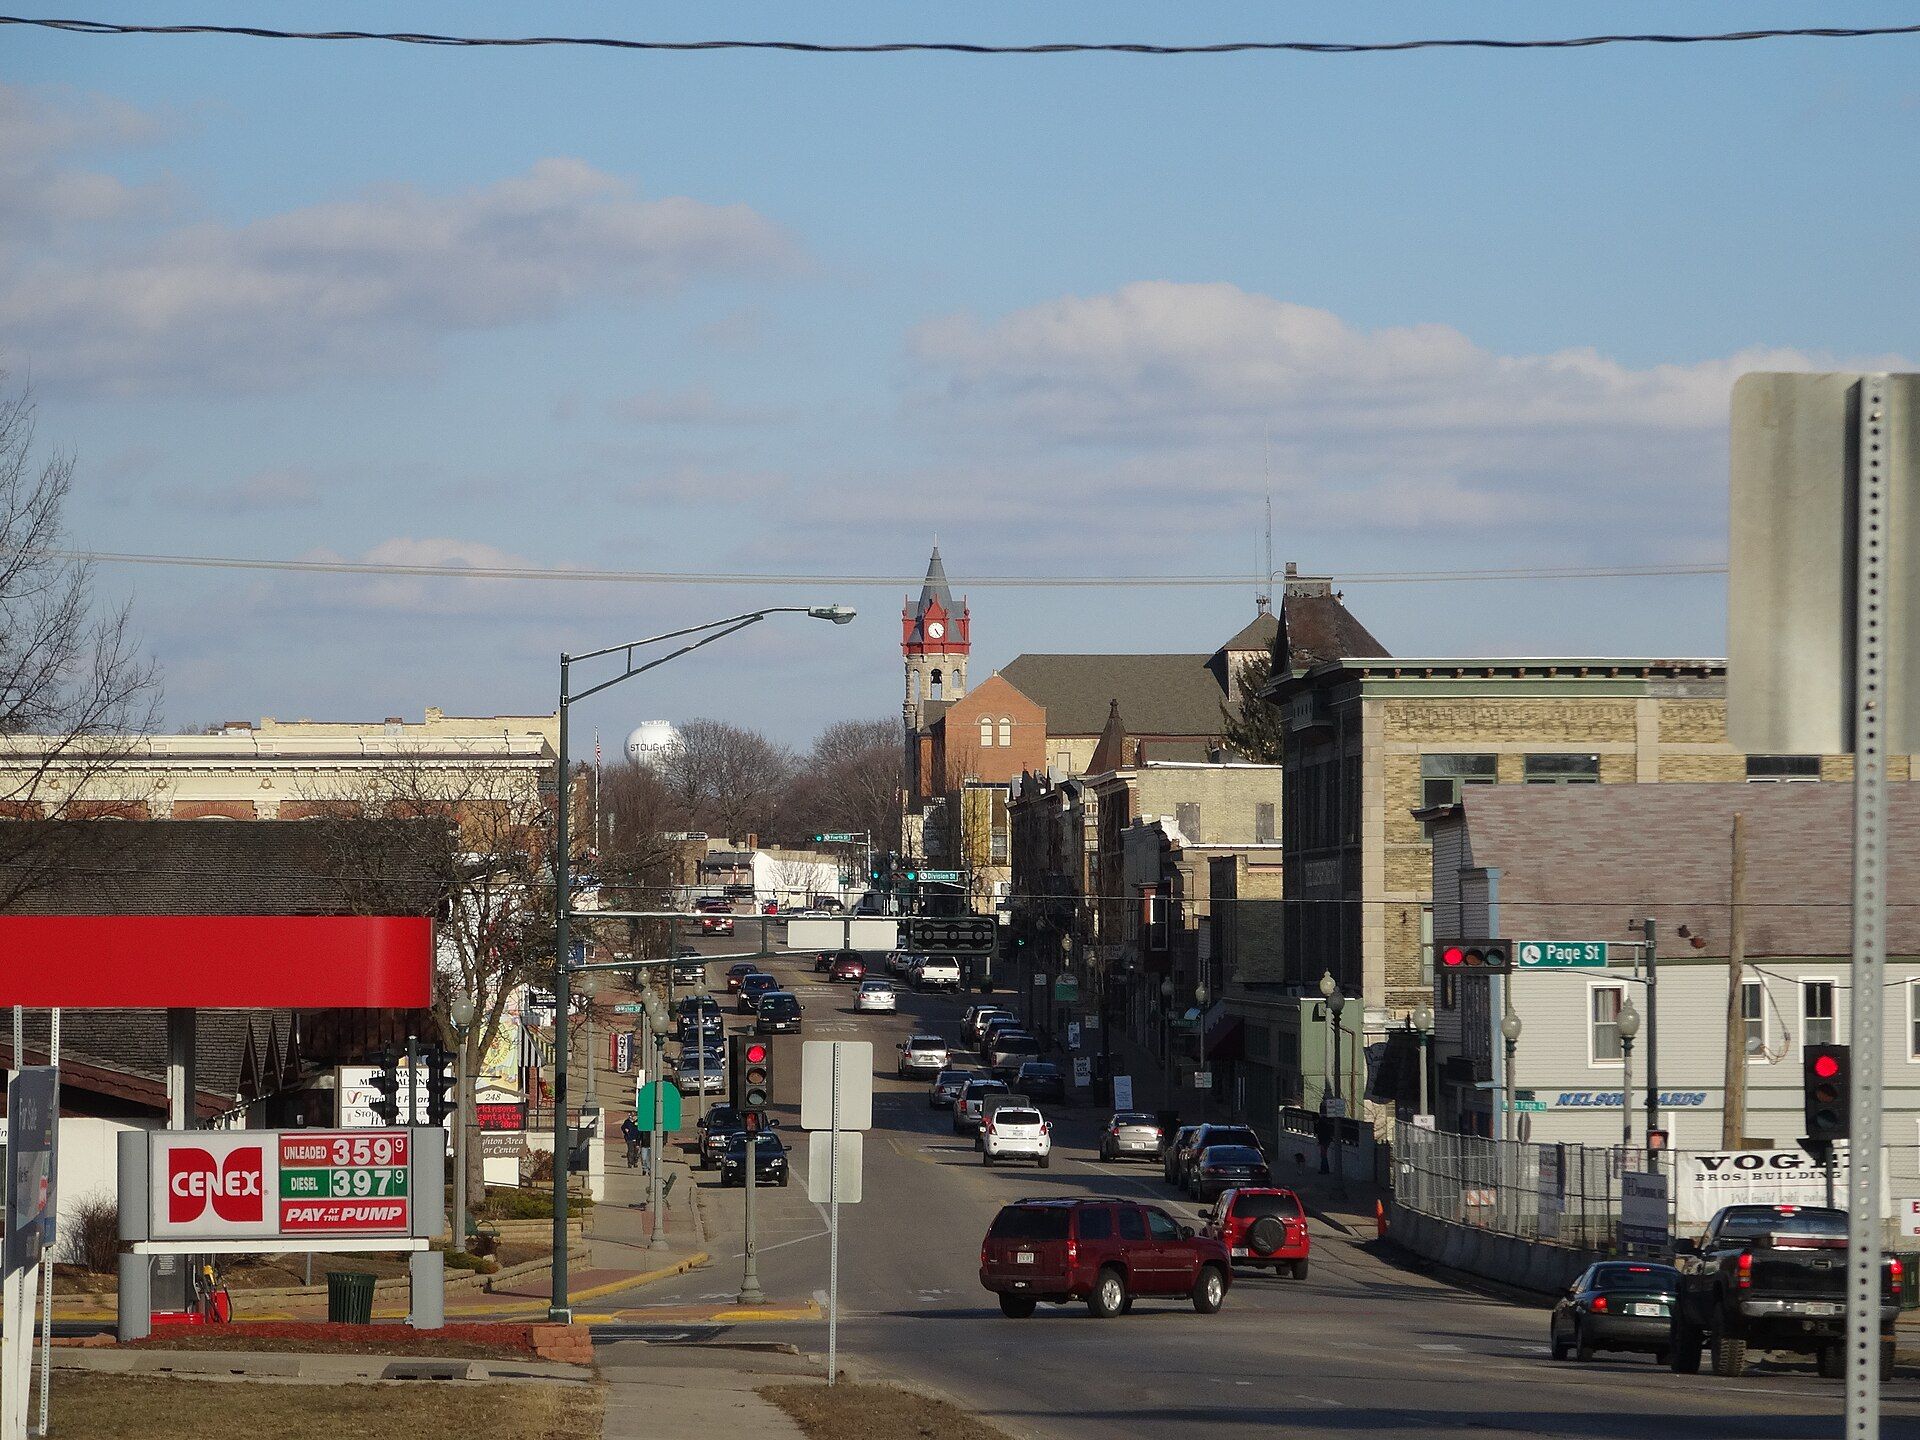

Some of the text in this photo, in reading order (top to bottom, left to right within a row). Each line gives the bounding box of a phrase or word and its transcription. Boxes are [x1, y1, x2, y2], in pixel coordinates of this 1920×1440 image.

[1546, 944, 1600, 964] Page St
[485, 1093, 501, 1101] 248
[1556, 1092, 1707, 1106] NELSO ARDS
[504, 1137, 524, 1145] Area
[284, 1139, 404, 1166] UNLEADED 359 9
[494, 1146, 520, 1154] Center
[290, 1170, 404, 1196] DIESEL 397 9
[1695, 1171, 1842, 1181] BROS. BUILDING
[172, 1170, 260, 1197] CENEX
[286, 1208, 327, 1222] PAY
[341, 1207, 403, 1221] PUMP
[323, 1214, 339, 1222] THE
